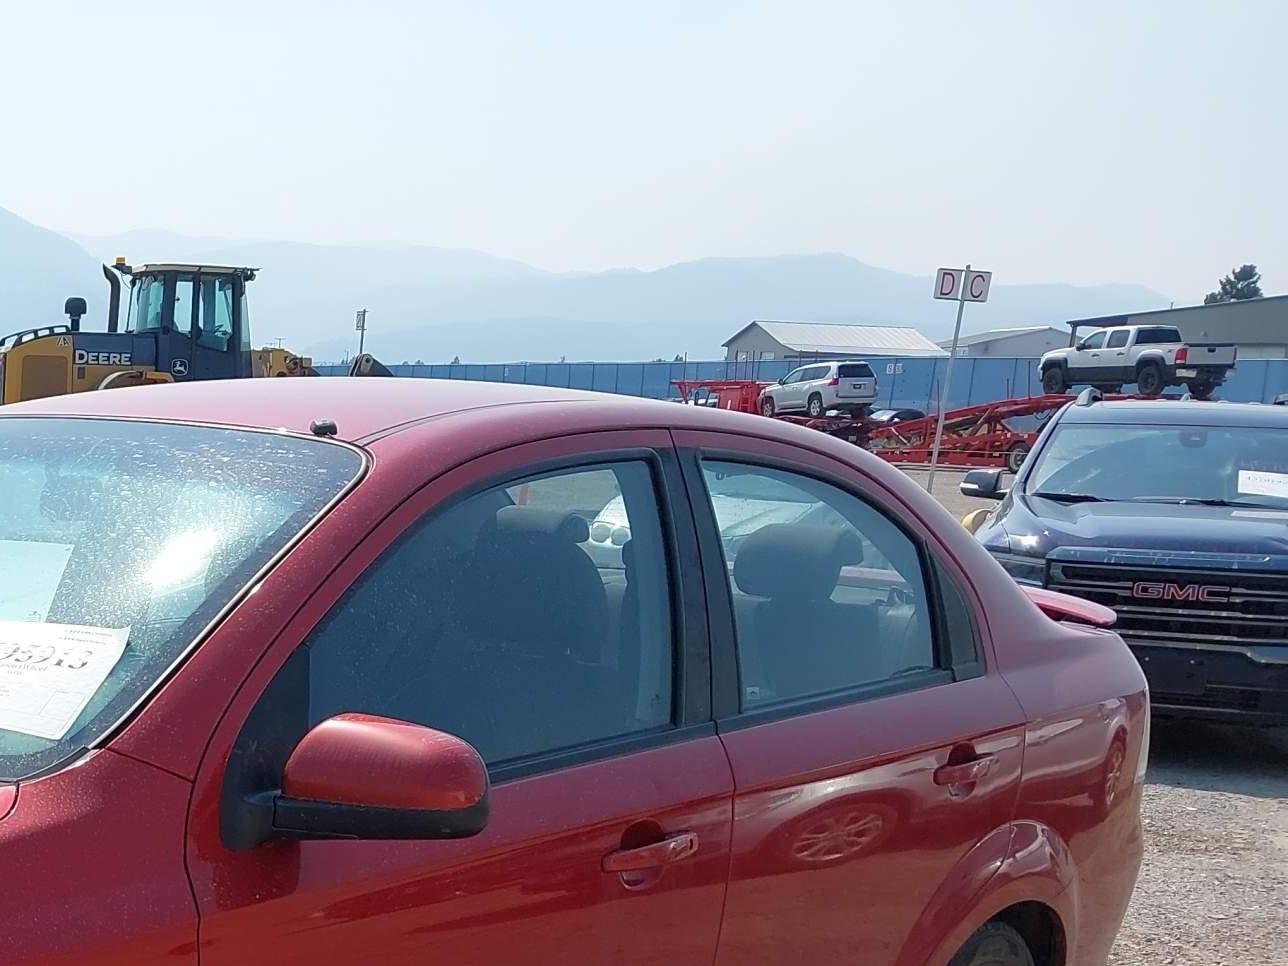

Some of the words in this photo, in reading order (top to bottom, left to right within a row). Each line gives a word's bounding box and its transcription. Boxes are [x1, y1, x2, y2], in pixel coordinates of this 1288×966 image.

[939, 271, 955, 296] D
[970, 274, 985, 298] C
[75, 350, 132, 365] DEERE
[1133, 582, 1230, 603] GMC
